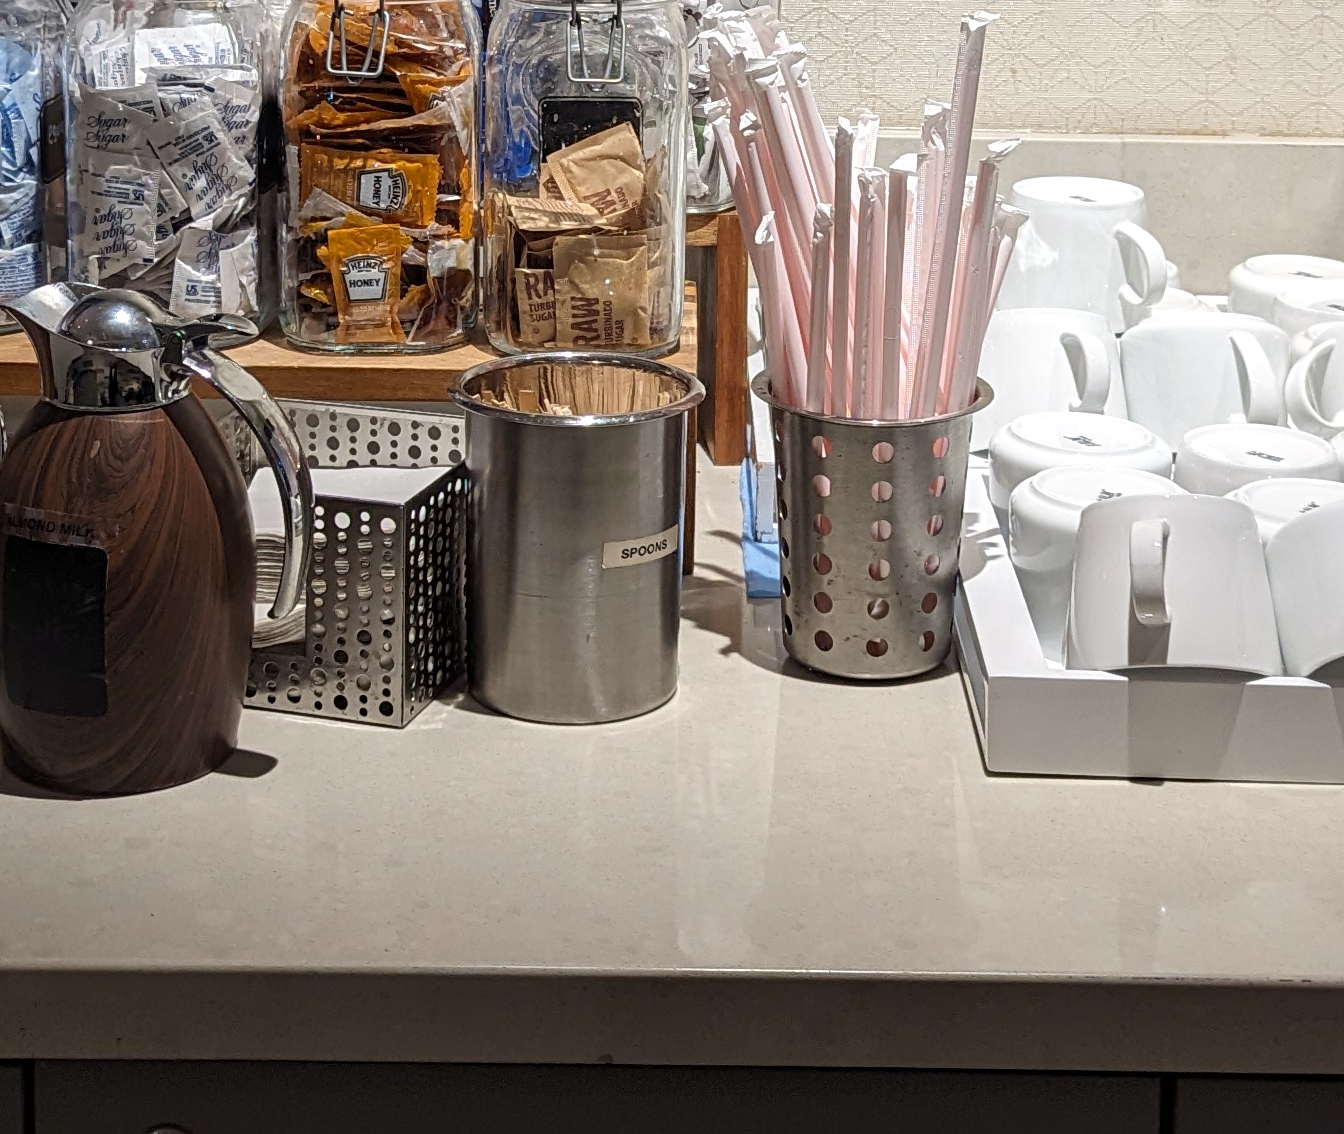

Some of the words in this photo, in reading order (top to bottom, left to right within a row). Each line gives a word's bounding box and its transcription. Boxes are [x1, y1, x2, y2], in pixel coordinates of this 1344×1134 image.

[86, 111, 131, 131] Sugar
[86, 129, 130, 150] Sugar
[185, 152, 218, 192] Sugar
[196, 163, 228, 203] Sugar
[205, 175, 238, 211] Sugar
[373, 176, 382, 208] HONEY
[391, 178, 401, 210] HEINZ
[93, 204, 134, 226] Sugar
[94, 222, 136, 242] Sugar
[100, 239, 137, 258] Sugar
[350, 259, 377, 271] HEINZ
[349, 277, 381, 288] HONEY
[524, 271, 556, 301] RA
[530, 311, 556, 323] SUGA
[570, 296, 600, 349] RAW
[602, 300, 613, 346] URBINADO
[59, 522, 96, 539] MILK
[621, 539, 668, 560] SPOONS
